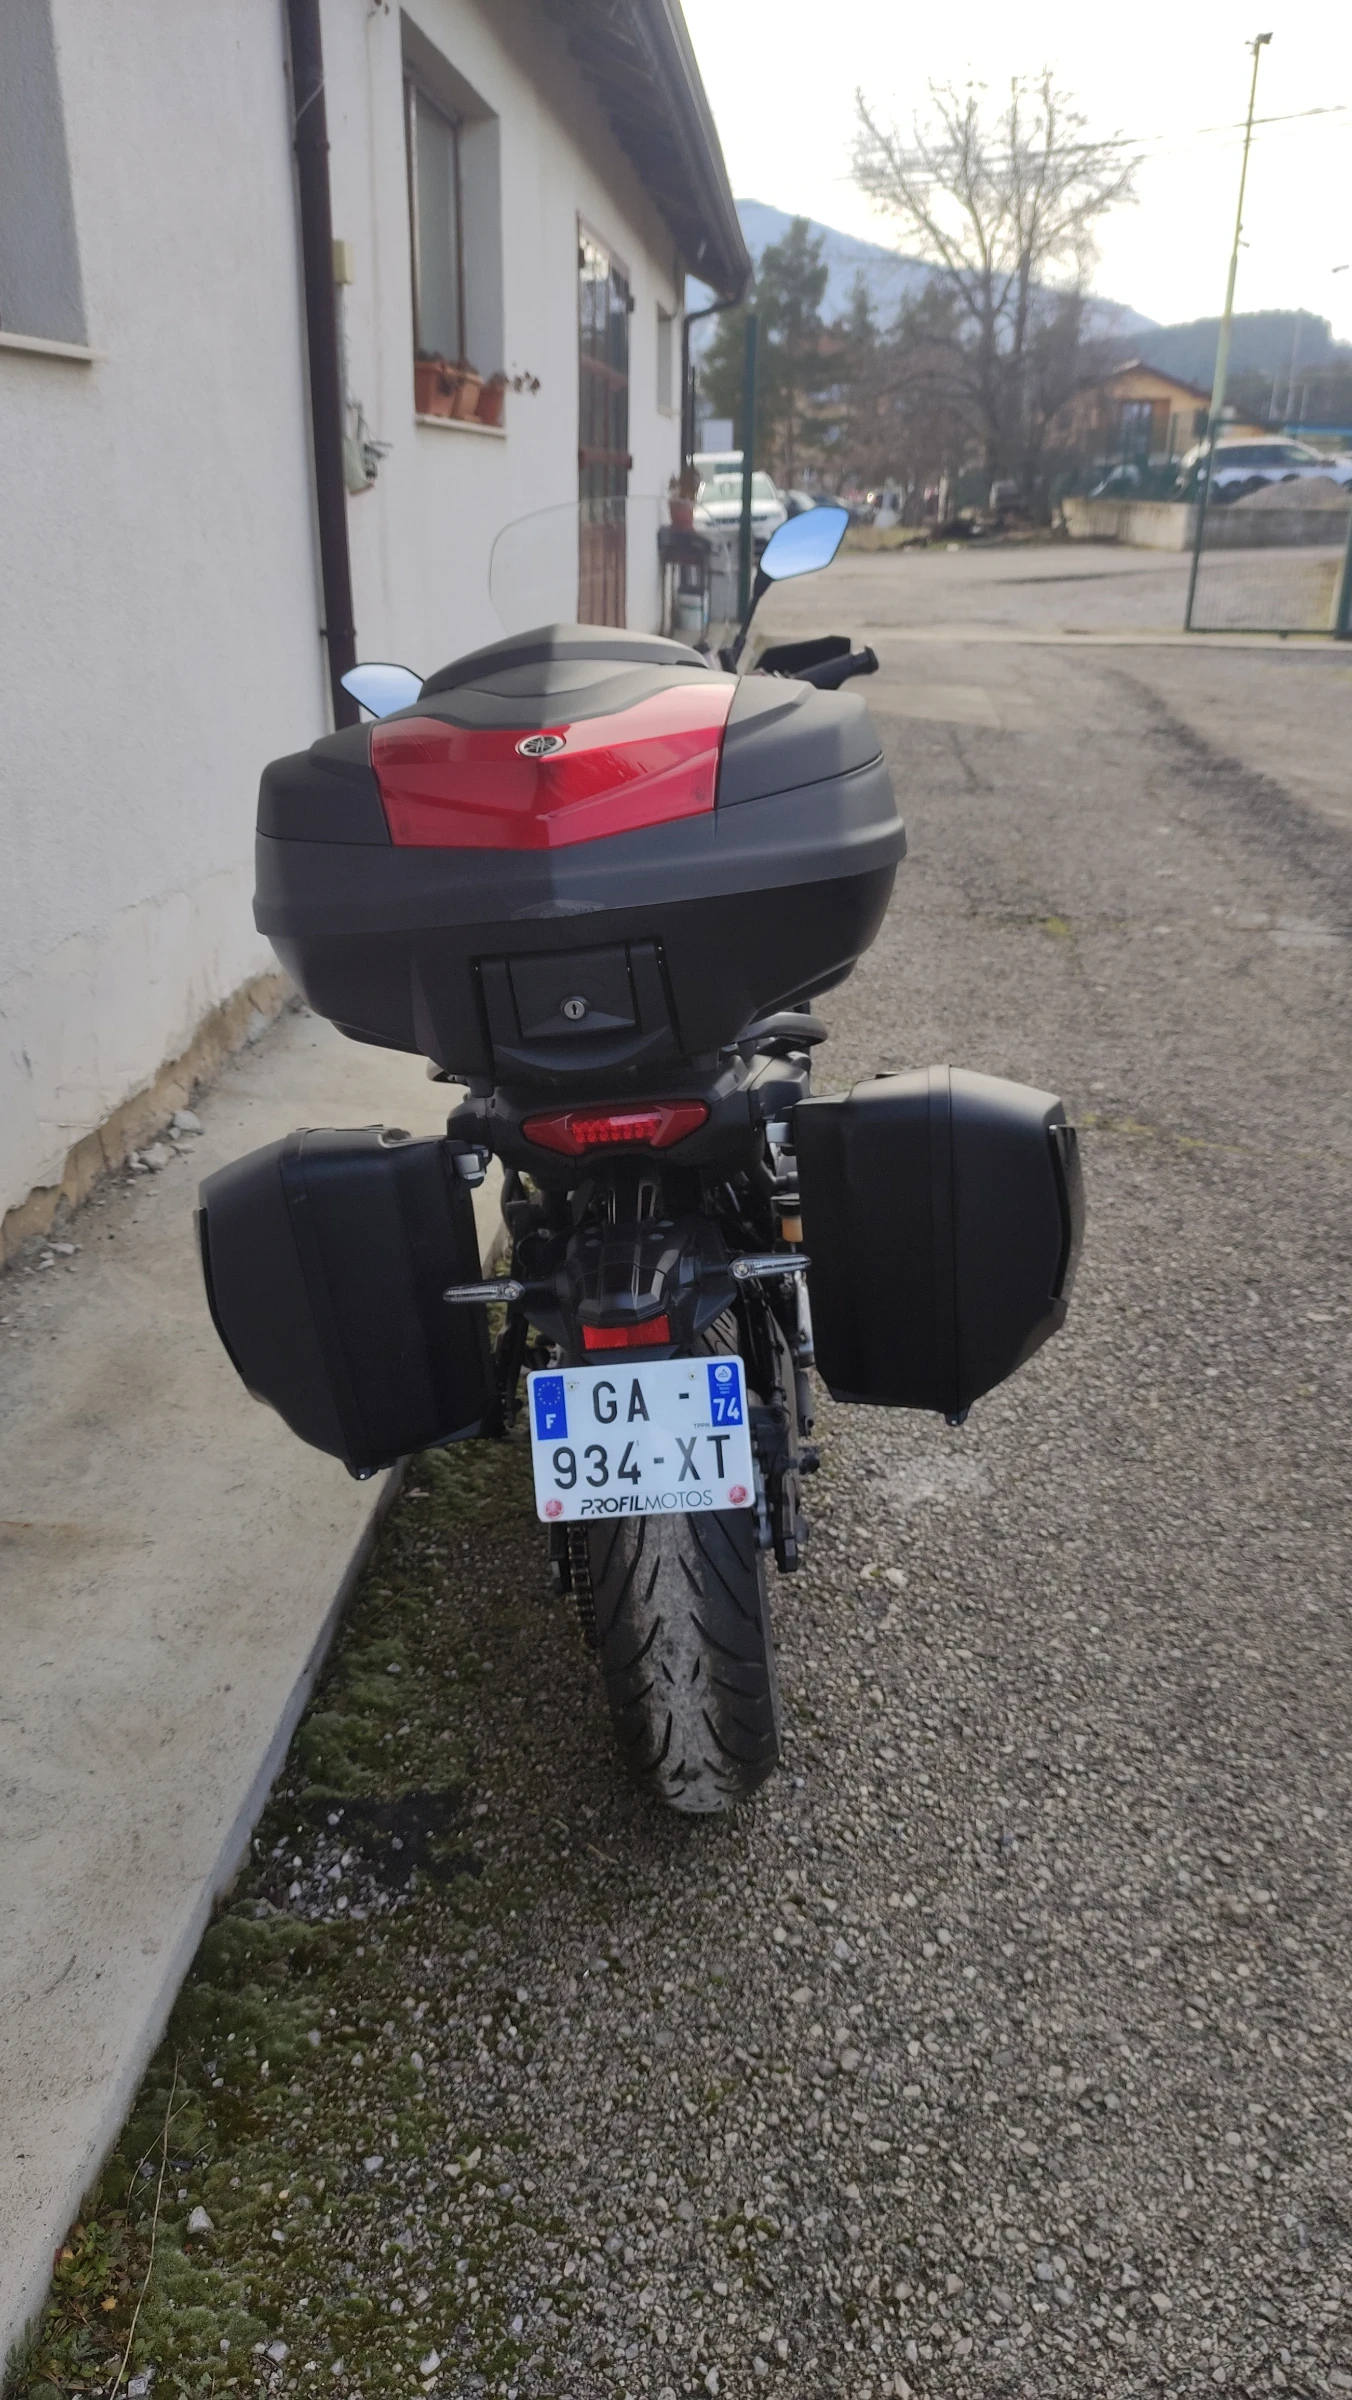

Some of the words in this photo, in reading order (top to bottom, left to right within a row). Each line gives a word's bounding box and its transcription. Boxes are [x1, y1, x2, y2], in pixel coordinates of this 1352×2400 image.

[592, 1378, 650, 1424] GA
[713, 1397, 740, 1421] 74
[545, 1413, 557, 1430] F
[552, 1434, 731, 1490] 934-XT
[580, 1489, 713, 1516] PROFILMOTOS
